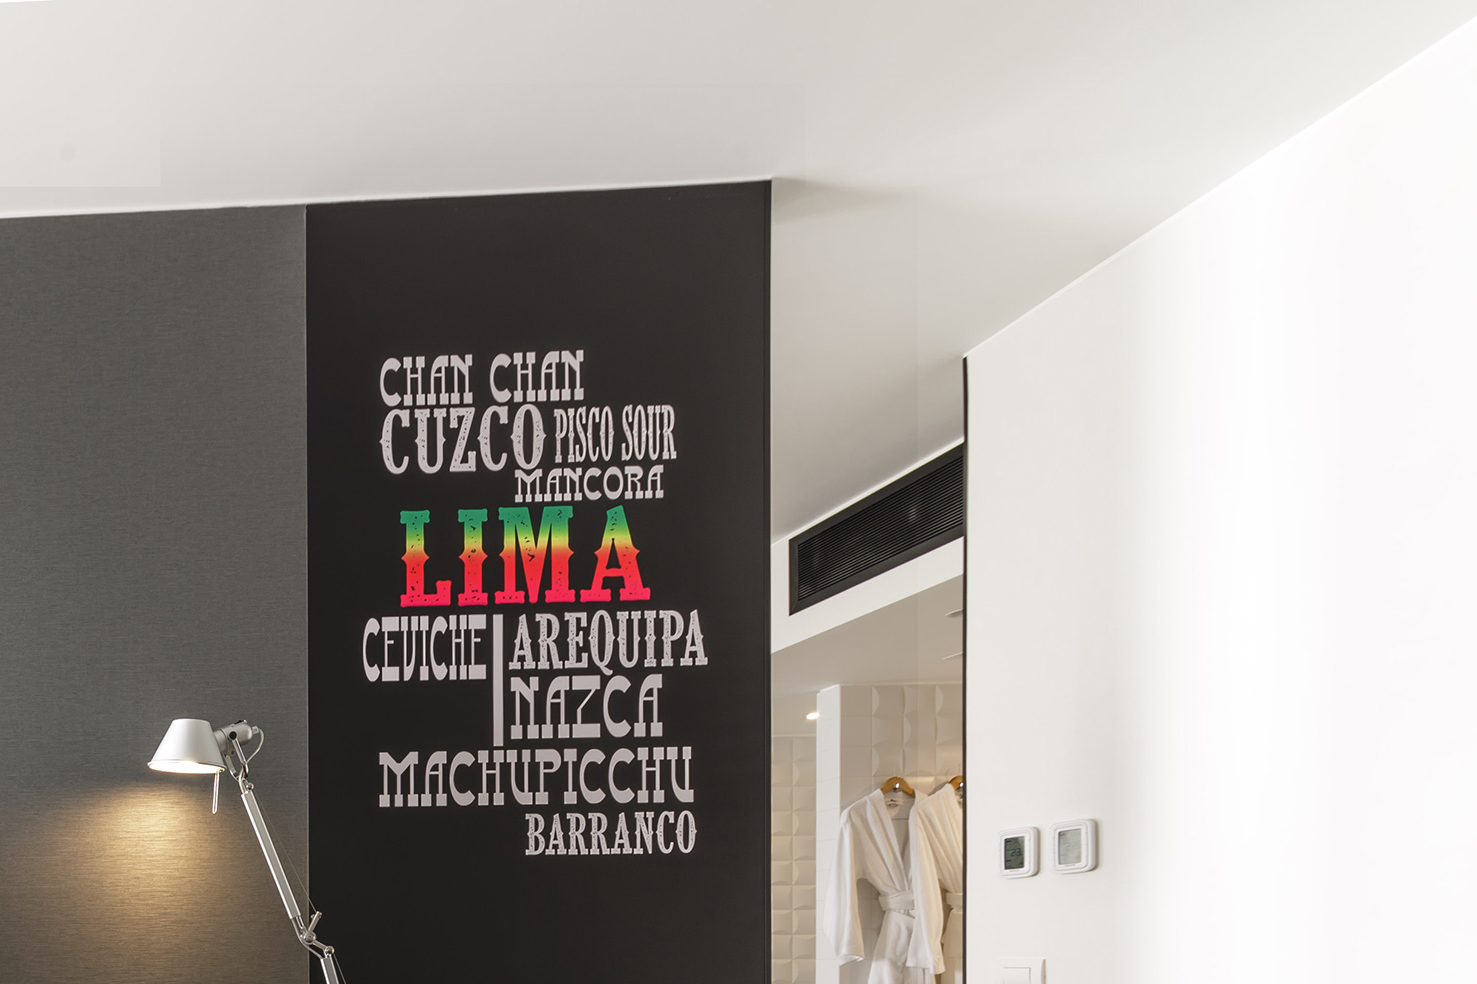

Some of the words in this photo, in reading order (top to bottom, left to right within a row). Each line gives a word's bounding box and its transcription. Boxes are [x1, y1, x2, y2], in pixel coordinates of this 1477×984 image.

[380, 354, 473, 406] CHAN
[489, 350, 584, 403] CHAN
[379, 404, 547, 475] CUZCO
[554, 406, 614, 463] PISCO
[621, 404, 677, 461] SOUR
[515, 465, 664, 502] MANCORA
[400, 505, 651, 607] LIMA
[362, 614, 487, 682] CEVICHE
[509, 609, 708, 675] AREQUIPA
[510, 674, 663, 739] NAZCA
[379, 746, 694, 807] MACHUPICCHU
[525, 810, 697, 855] BARRANCO
